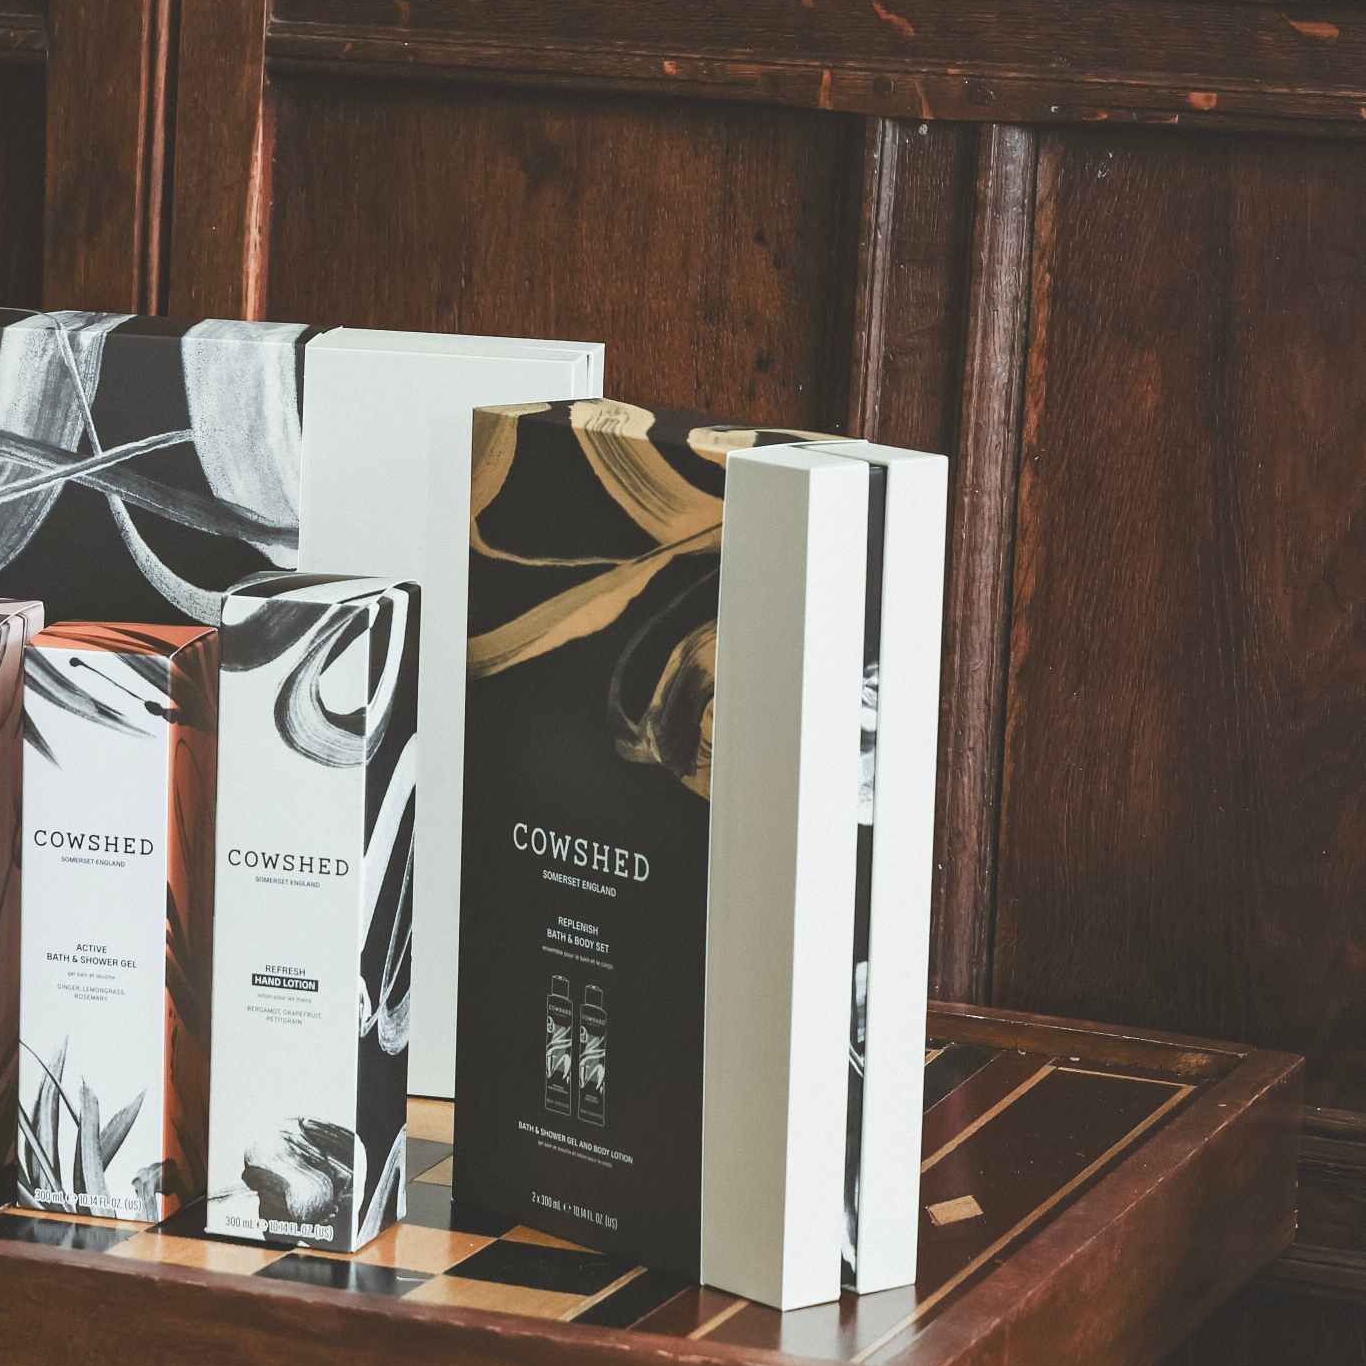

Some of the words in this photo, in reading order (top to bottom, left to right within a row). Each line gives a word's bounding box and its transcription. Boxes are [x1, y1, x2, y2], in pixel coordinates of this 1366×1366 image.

[34, 830, 153, 855] COWSHED
[513, 823, 649, 881] COWSHED
[62, 856, 94, 865] SOMERSET
[96, 859, 125, 867] ENGLAND
[228, 849, 348, 876] COWSHED
[255, 876, 288, 885] SOMERSET
[290, 879, 320, 887] ENGLAND
[543, 870, 580, 888] SOMERSET
[582, 880, 616, 897] ENGLAND
[558, 916, 598, 935] REPLENISH
[76, 944, 107, 953] ACTIVE
[547, 928, 566, 941] BATH
[568, 934, 572, 943] &
[575, 937, 594, 949] BODY
[596, 942, 609, 954] SET
[47, 953, 69, 962] BATH
[80, 956, 118, 966] SHOWER
[121, 960, 137, 968] GEL
[266, 965, 305, 976] REFRESH
[57, 984, 81, 992] GINGER,
[83, 986, 126, 995] LEMONGRASS,
[255, 976, 281, 986] HAND
[283, 979, 316, 990] LOTION
[247, 1006, 282, 1015] BERGAMOT,
[283, 1009, 322, 1019] GRAPEFRUIT,
[266, 1016, 302, 1024] PETITGRAIN
[519, 1121, 534, 1132] BATH
[535, 1127, 539, 1135] &
[541, 1128, 565, 1143] SHOWER
[567, 1136, 578, 1147] GEL
[579, 1141, 592, 1151] AND
[594, 1145, 610, 1156] BODY
[611, 1150, 633, 1164] LOTION
[35, 1190, 50, 1200] 300
[53, 1194, 63, 1202] mL
[80, 1195, 97, 1205] 10.14
[124, 1199, 142, 1211] (US)
[532, 1192, 535, 1202] 2
[541, 1195, 552, 1207] 300
[553, 1200, 560, 1211] mL
[605, 1215, 617, 1230] (US)
[226, 1216, 240, 1227] 300
[243, 1220, 253, 1229] mL
[315, 1224, 333, 1240] (US)
